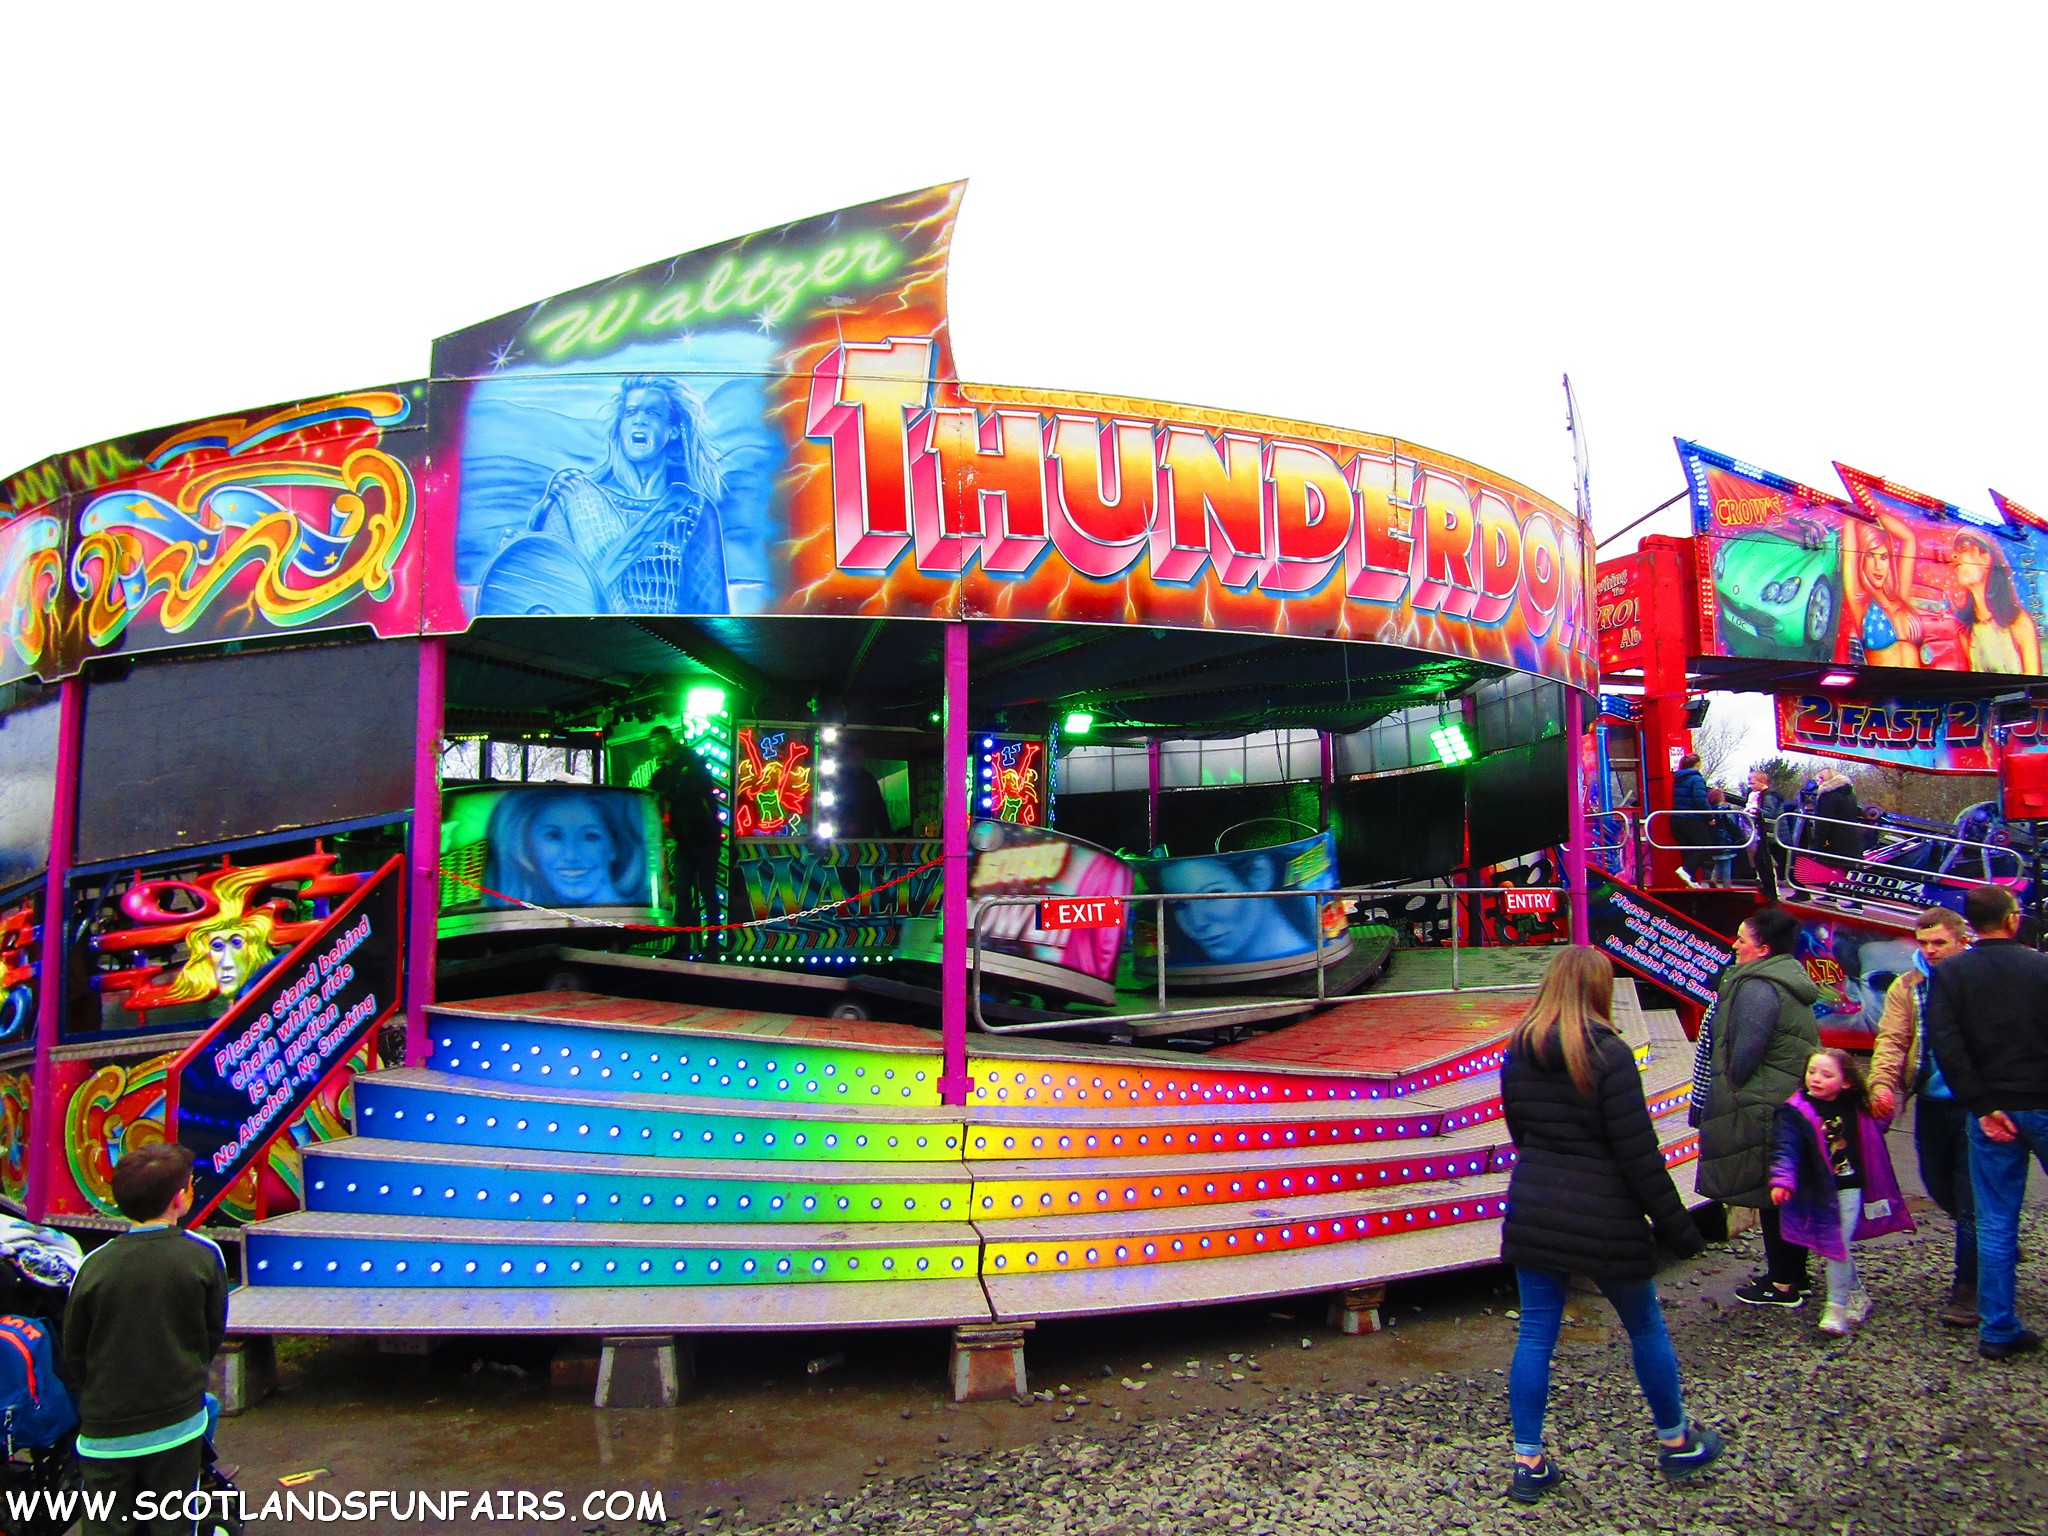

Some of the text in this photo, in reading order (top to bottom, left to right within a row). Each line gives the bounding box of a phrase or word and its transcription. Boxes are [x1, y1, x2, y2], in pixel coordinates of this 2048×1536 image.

[534, 238, 895, 357] Waltzer
[1716, 496, 1782, 526] CROW'S
[1795, 694, 1835, 740] 2
[1838, 704, 1940, 745] FAST
[1945, 701, 1981, 743] 2
[734, 853, 944, 931] WALTZ
[1058, 903, 1107, 924] EXIT
[1507, 893, 1552, 910] ENTRY
[1846, 870, 1925, 896] 100%
[1609, 891, 1733, 966] Please stand behind
[1624, 916, 1719, 974] chain while ride
[1635, 936, 1708, 983] is in motion
[214, 914, 372, 1077] Please stand behind
[1605, 934, 1623, 949] No
[1622, 944, 1665, 974] Alcohol
[1667, 969, 1686, 985] No
[1686, 978, 1718, 1003] Smok
[1806, 957, 1845, 986] AZY
[231, 962, 355, 1091] chain while ride
[248, 1004, 340, 1104] is in motion
[212, 1140, 239, 1174] No
[238, 1084, 292, 1148] Alcohol
[298, 1053, 321, 1081] No
[318, 993, 377, 1058] Smoking
